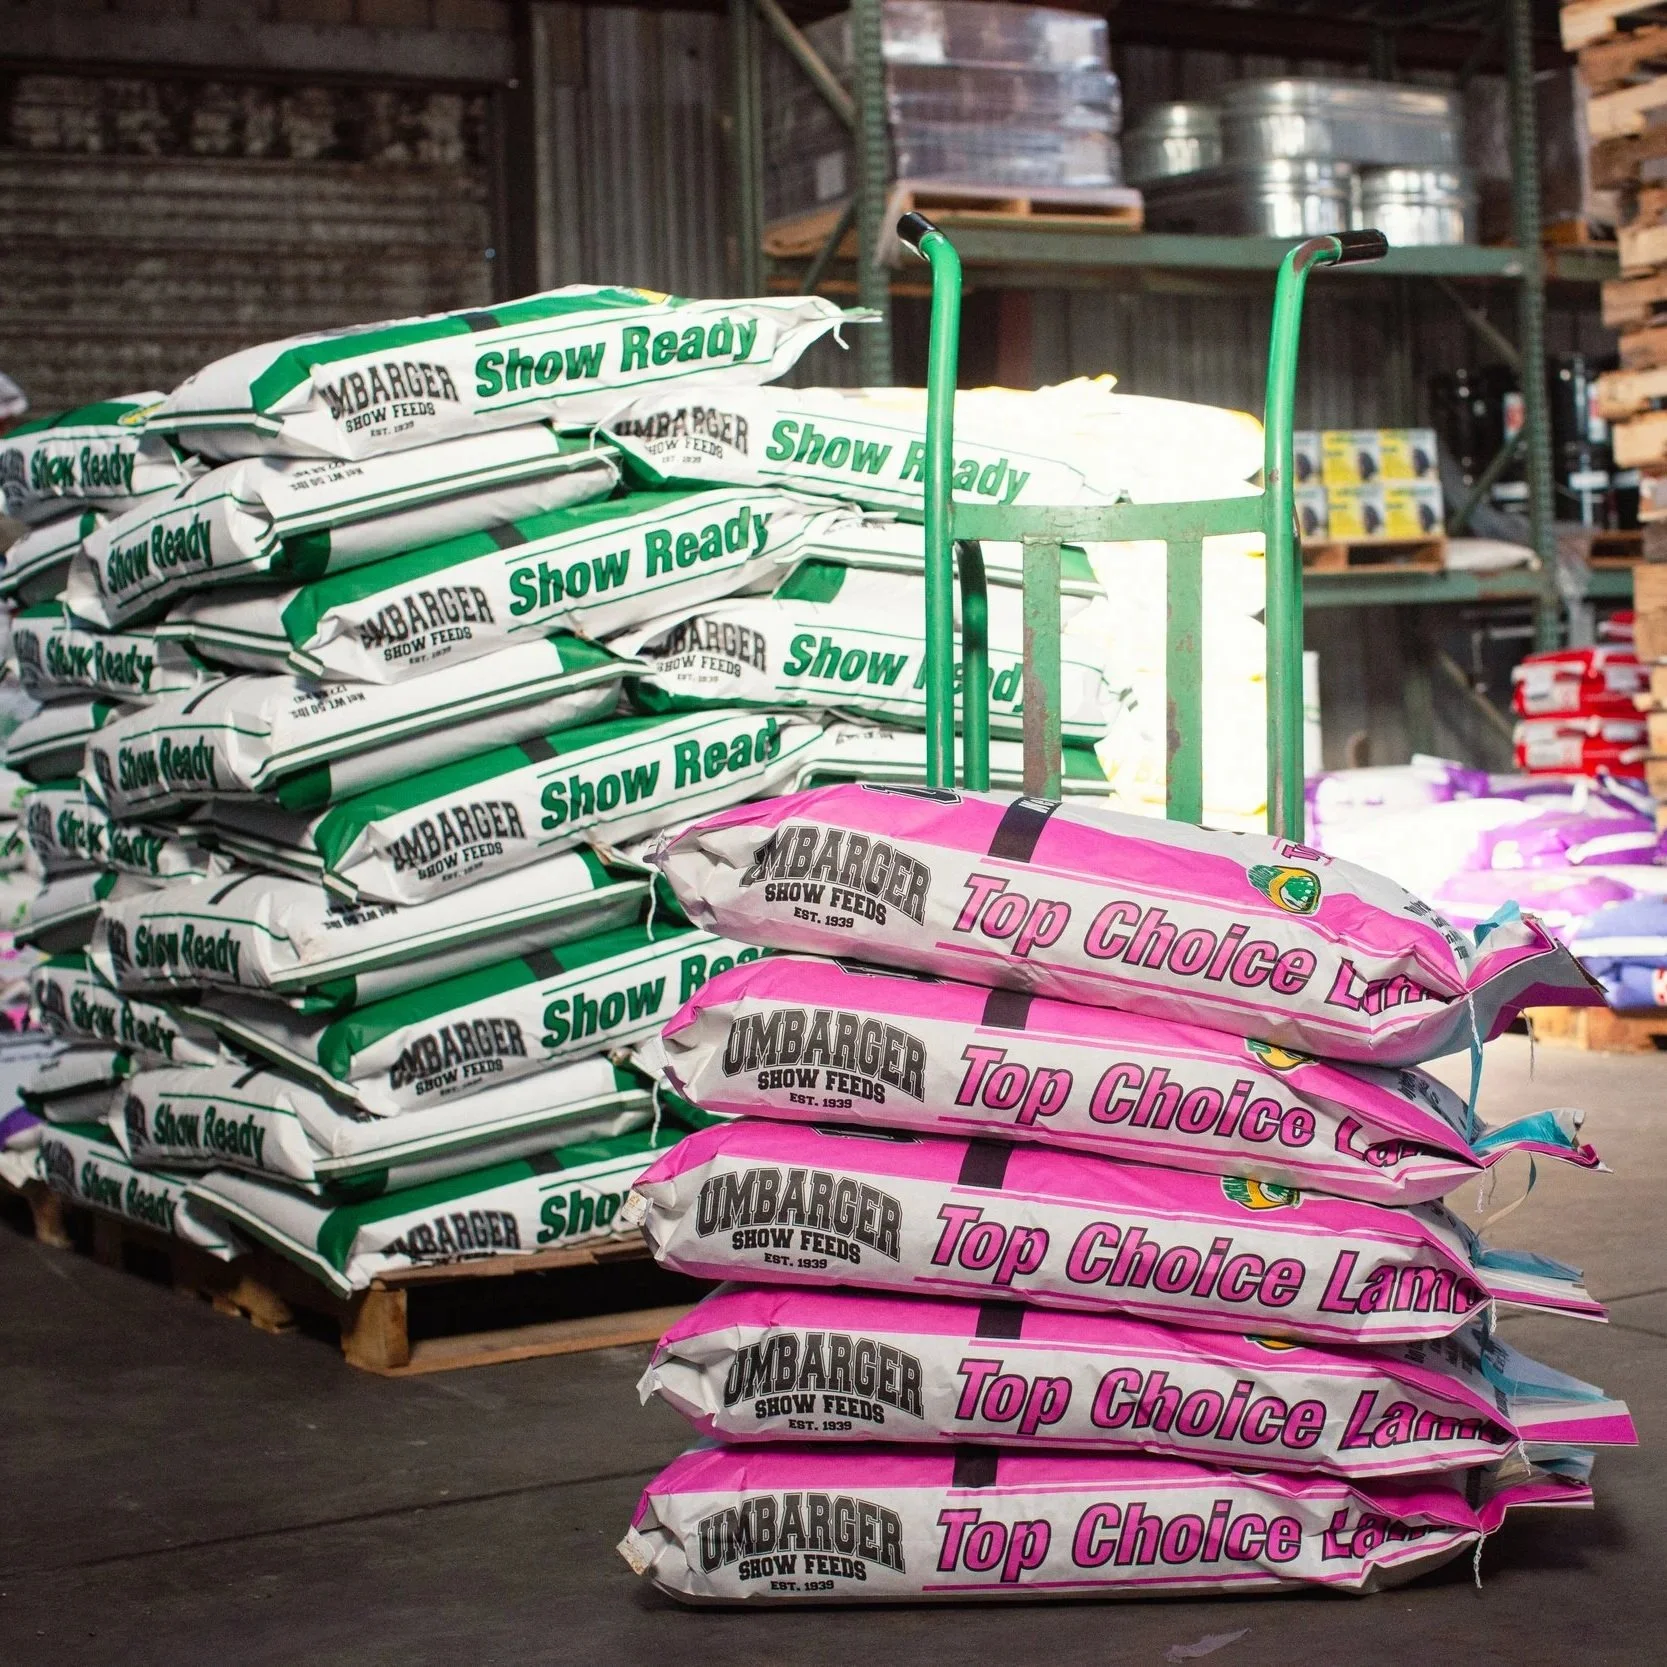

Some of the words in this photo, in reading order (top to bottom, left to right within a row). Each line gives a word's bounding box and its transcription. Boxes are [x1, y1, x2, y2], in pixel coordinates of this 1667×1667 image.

[475, 343, 607, 399] Show
[620, 316, 758, 374] Ready
[345, 407, 387, 434] SHOW
[392, 402, 436, 418] FEEDS
[80, 443, 136, 495] Ready
[685, 437, 723, 460] FEEDS
[766, 420, 893, 476] Show
[899, 441, 1031, 506] Rady
[107, 539, 150, 594] Show
[151, 512, 214, 570] Ready
[508, 549, 630, 617] Show
[644, 506, 773, 578] Ready
[384, 636, 426, 661] SHOW
[430, 626, 473, 646] FEEDS
[636, 615, 766, 673] BARGER
[701, 656, 742, 678] FEEDS
[783, 633, 909, 687] Show
[159, 735, 219, 791] Ready
[540, 760, 660, 831] Show
[674, 717, 782, 790] Read
[418, 853, 458, 880] SHOW
[462, 842, 503, 862] FEEDS
[764, 882, 827, 905] SHOW
[830, 887, 888, 926] FEEDS
[793, 906, 821, 924] EST.
[824, 914, 854, 928] 1939
[180, 923, 241, 985] Ready
[952, 872, 1073, 957] Top
[1083, 900, 1317, 996] Choice
[541, 976, 666, 1048] Show
[415, 1068, 458, 1096] SHOW
[462, 1058, 504, 1079] FEEDS
[722, 1008, 927, 1102] UMBARGER
[757, 1068, 817, 1091] SHOW
[825, 1070, 886, 1104] FEEDS
[789, 1092, 819, 1107] EST.
[823, 1097, 852, 1109] 1939
[954, 1044, 1074, 1127] Top
[1089, 1062, 1316, 1148] Choice
[154, 1103, 200, 1150] Show
[204, 1105, 265, 1169] Ready
[126, 1178, 176, 1235] Ready
[537, 1189, 638, 1243] Sho
[695, 1167, 902, 1262] UMBARGER
[732, 1228, 795, 1251] SHOW
[800, 1229, 861, 1264] FEEDS
[764, 1252, 794, 1267] EST.
[797, 1257, 828, 1269] 1939
[931, 1203, 1050, 1285] Top
[1065, 1221, 1306, 1308] Choice
[724, 1332, 925, 1420] UMBARGER
[755, 1394, 815, 1419] SHOW
[824, 1394, 886, 1425] FEEDS
[788, 1418, 819, 1431] EST.
[822, 1420, 852, 1431] 1939
[955, 1358, 1073, 1436] Top
[1090, 1367, 1327, 1450] Choice
[1337, 1389, 1508, 1451] Lam
[699, 1492, 906, 1576] UMBARGER
[937, 1508, 1052, 1584] Top
[1071, 1499, 1301, 1568] Choice
[1321, 1507, 1445, 1561] La
[738, 1555, 798, 1581] SHOW
[805, 1554, 867, 1582] FEEDS
[770, 1581, 800, 1592] EST.
[804, 1580, 835, 1592] 1939
